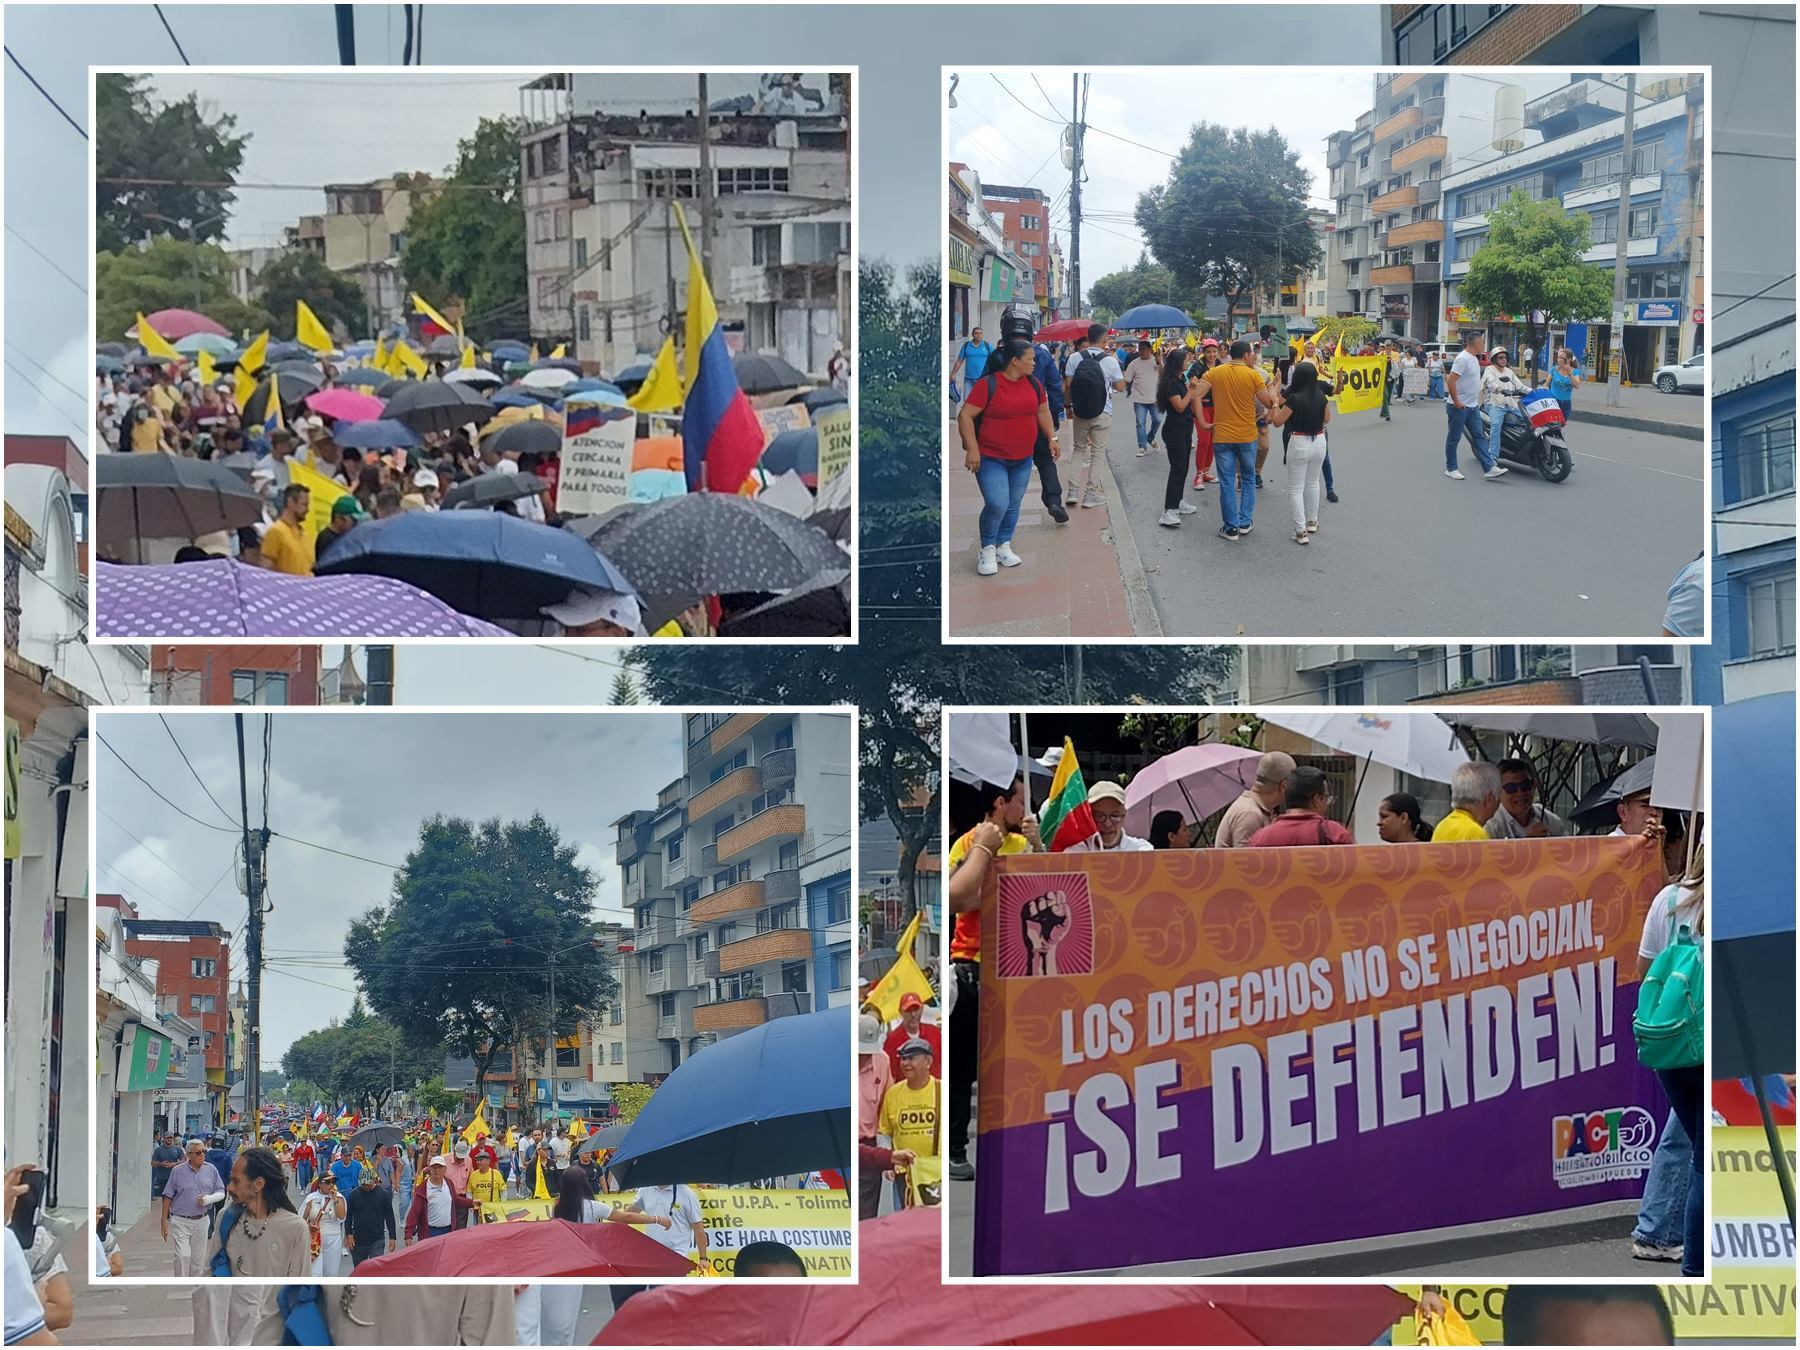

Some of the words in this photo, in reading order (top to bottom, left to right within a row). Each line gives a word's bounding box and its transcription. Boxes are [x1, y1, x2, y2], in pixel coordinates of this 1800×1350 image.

[1336, 367, 1381, 391] POLO
[571, 452, 622, 465] CERCANA
[566, 467, 572, 476] Y
[574, 467, 625, 479] PRIMARIA
[561, 481, 588, 492] PARA
[591, 482, 627, 495] TODOS
[1061, 998, 1134, 1066] LOS
[1147, 957, 1334, 1048] DERECHOS
[1341, 945, 1389, 1004] NO
[1397, 934, 1440, 991] SE
[1044, 1058, 1182, 1214] ¡SE
[1210, 956, 1616, 1170] DEFIENDEN!
[901, 1112, 935, 1124] POLO
[733, 1196, 779, 1209] U.P.A.
[702, 1214, 743, 1228] ente
[715, 1231, 734, 1246] SE
